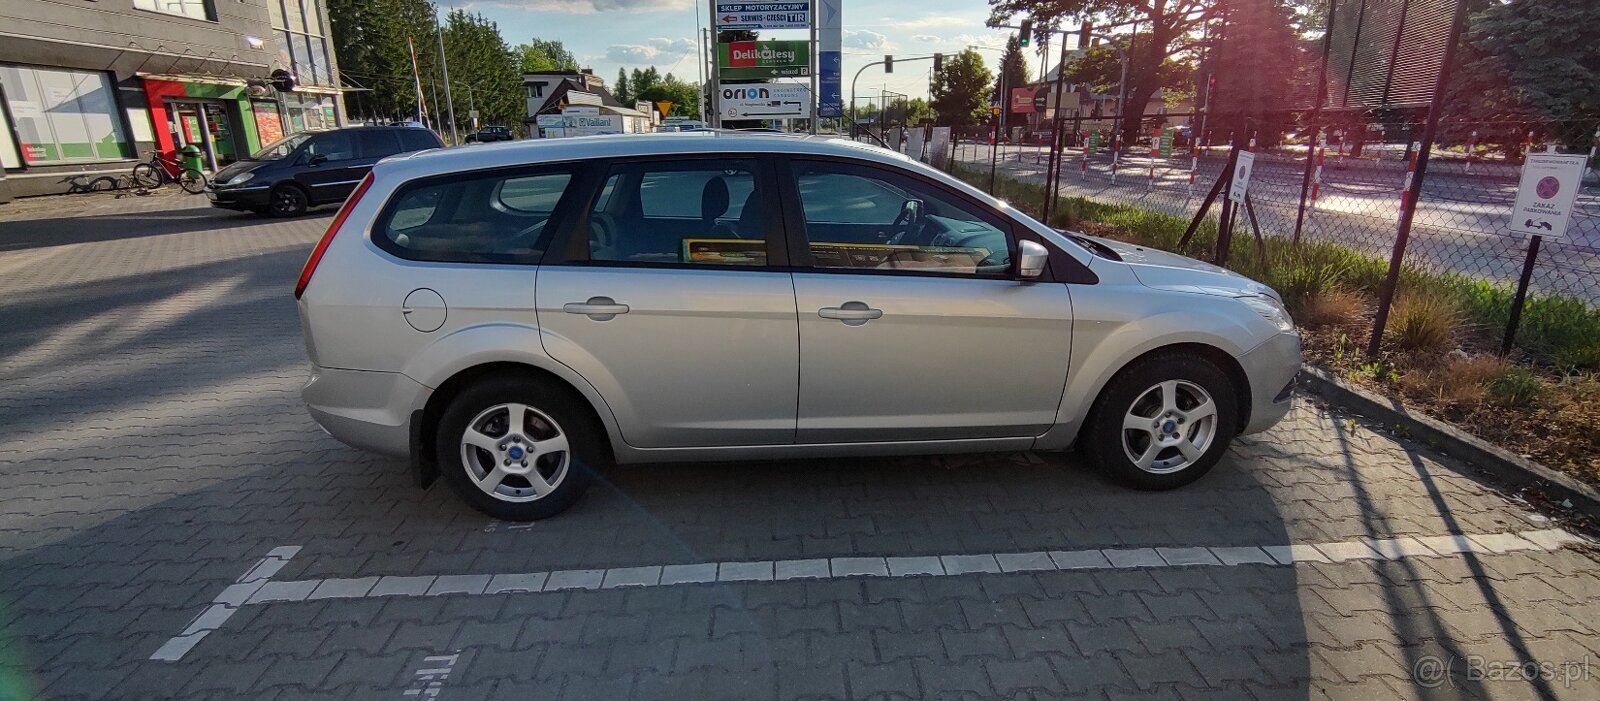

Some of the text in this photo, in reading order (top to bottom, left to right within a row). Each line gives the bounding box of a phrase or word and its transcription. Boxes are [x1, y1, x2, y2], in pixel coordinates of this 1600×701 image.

[788, 13, 805, 21] TIR
[733, 48, 795, 62] Delikatesy
[585, 118, 612, 127] Vaillant
[1532, 202, 1555, 210] ZAKAZ
